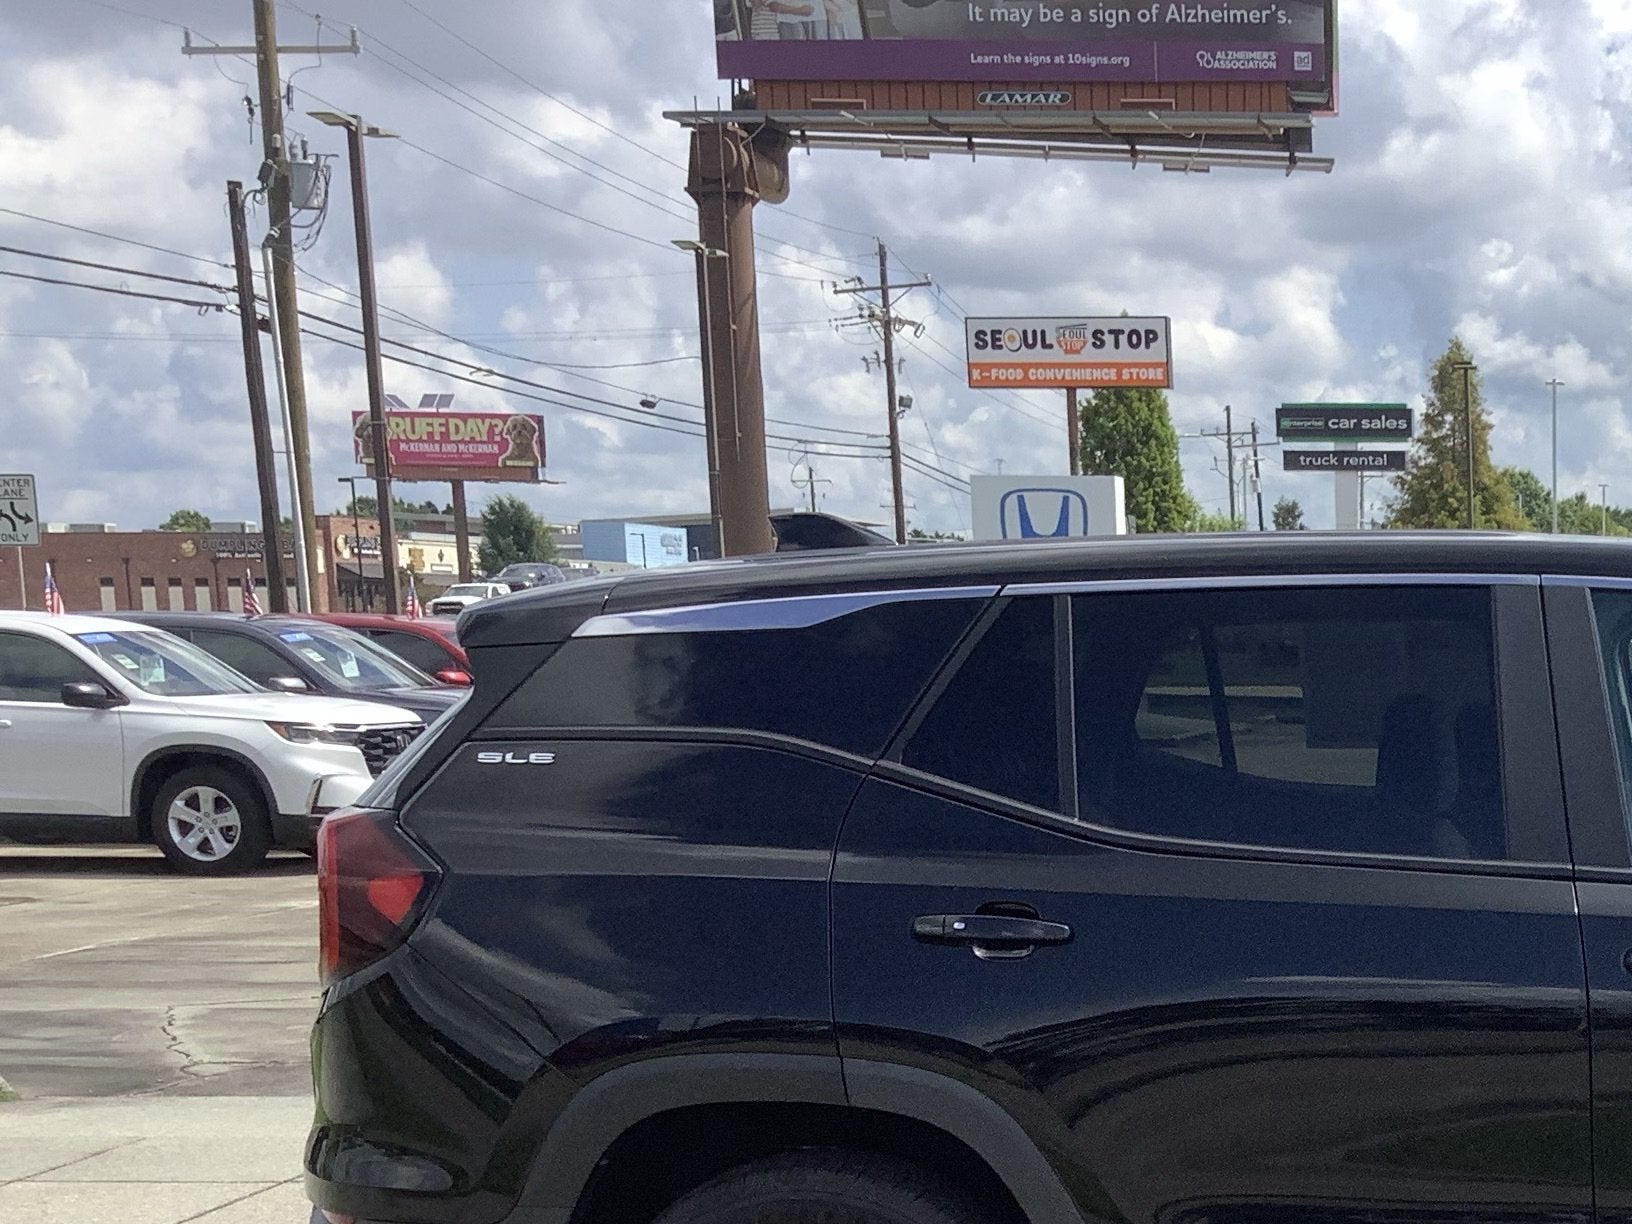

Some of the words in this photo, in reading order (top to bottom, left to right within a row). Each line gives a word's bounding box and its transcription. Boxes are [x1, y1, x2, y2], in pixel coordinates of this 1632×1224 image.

[968, 3, 983, 22] It
[990, 8, 1032, 27] may
[1039, 4, 1064, 22] be
[1071, 8, 1082, 23] a
[1088, 4, 1130, 28] sign
[1137, 4, 1160, 23] of
[1165, 3, 1292, 25] Alzheimer's.
[970, 53, 1000, 64] Learn
[1003, 53, 1022, 64] the
[1024, 53, 1051, 66] signs
[1054, 54, 1065, 64] at
[1067, 53, 1130, 67] 10signs.org
[1213, 60, 1277, 69] ASSOCIATION
[984, 92, 1063, 104] LAMAR
[974, 328, 1054, 352] SEOUL
[1092, 328, 1159, 350] STOP
[972, 368, 1024, 381] K-FOOD
[1028, 368, 1117, 381] CONVENIENCE
[1121, 367, 1164, 381] STORE
[388, 417, 446, 441] RUFF
[450, 417, 504, 442] DAY?
[1328, 418, 1358, 430] car
[1361, 415, 1408, 430] sales
[441, 443, 458, 453] AND
[1299, 453, 1338, 466] truck
[1343, 453, 1388, 466] rental
[1, 533, 29, 542] ONLY
